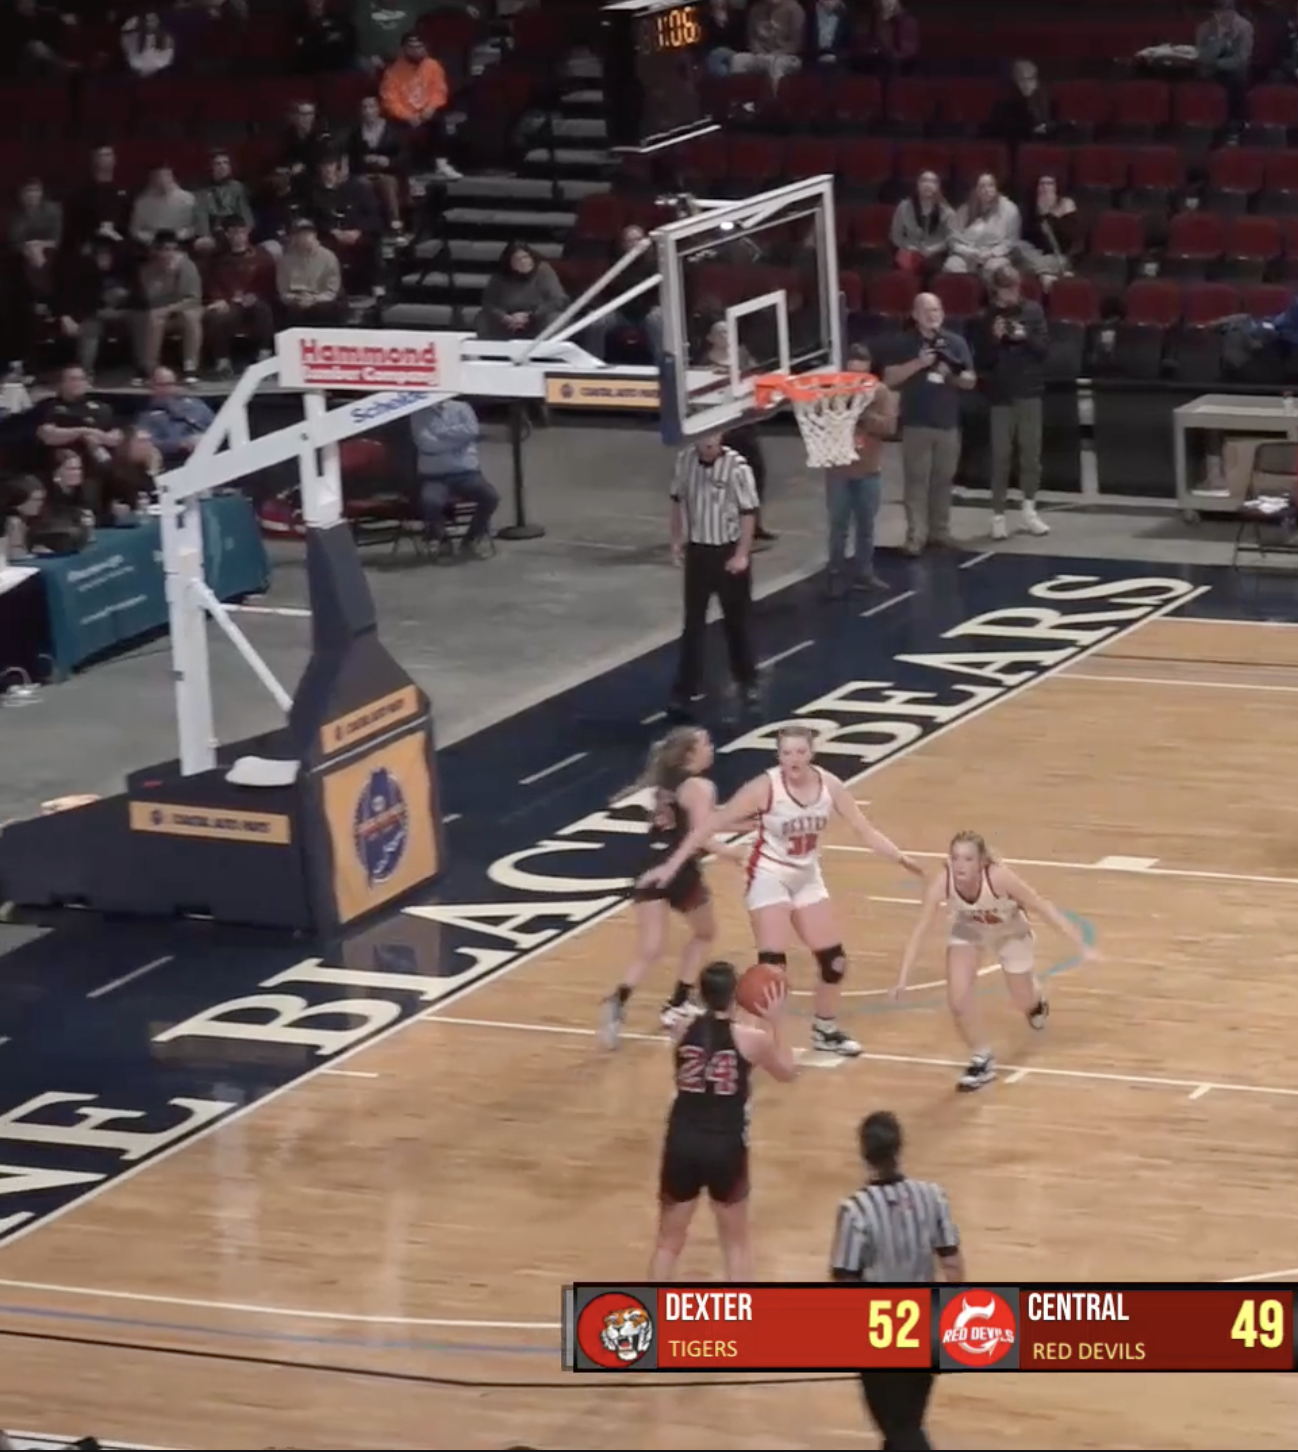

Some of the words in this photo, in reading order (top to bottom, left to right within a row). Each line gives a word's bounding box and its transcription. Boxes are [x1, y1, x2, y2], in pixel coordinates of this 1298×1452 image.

[657, 6, 696, 47] 1:06
[300, 338, 437, 363] Hammond
[717, 574, 1195, 762] BEARS
[678, 1045, 739, 1096] 24
